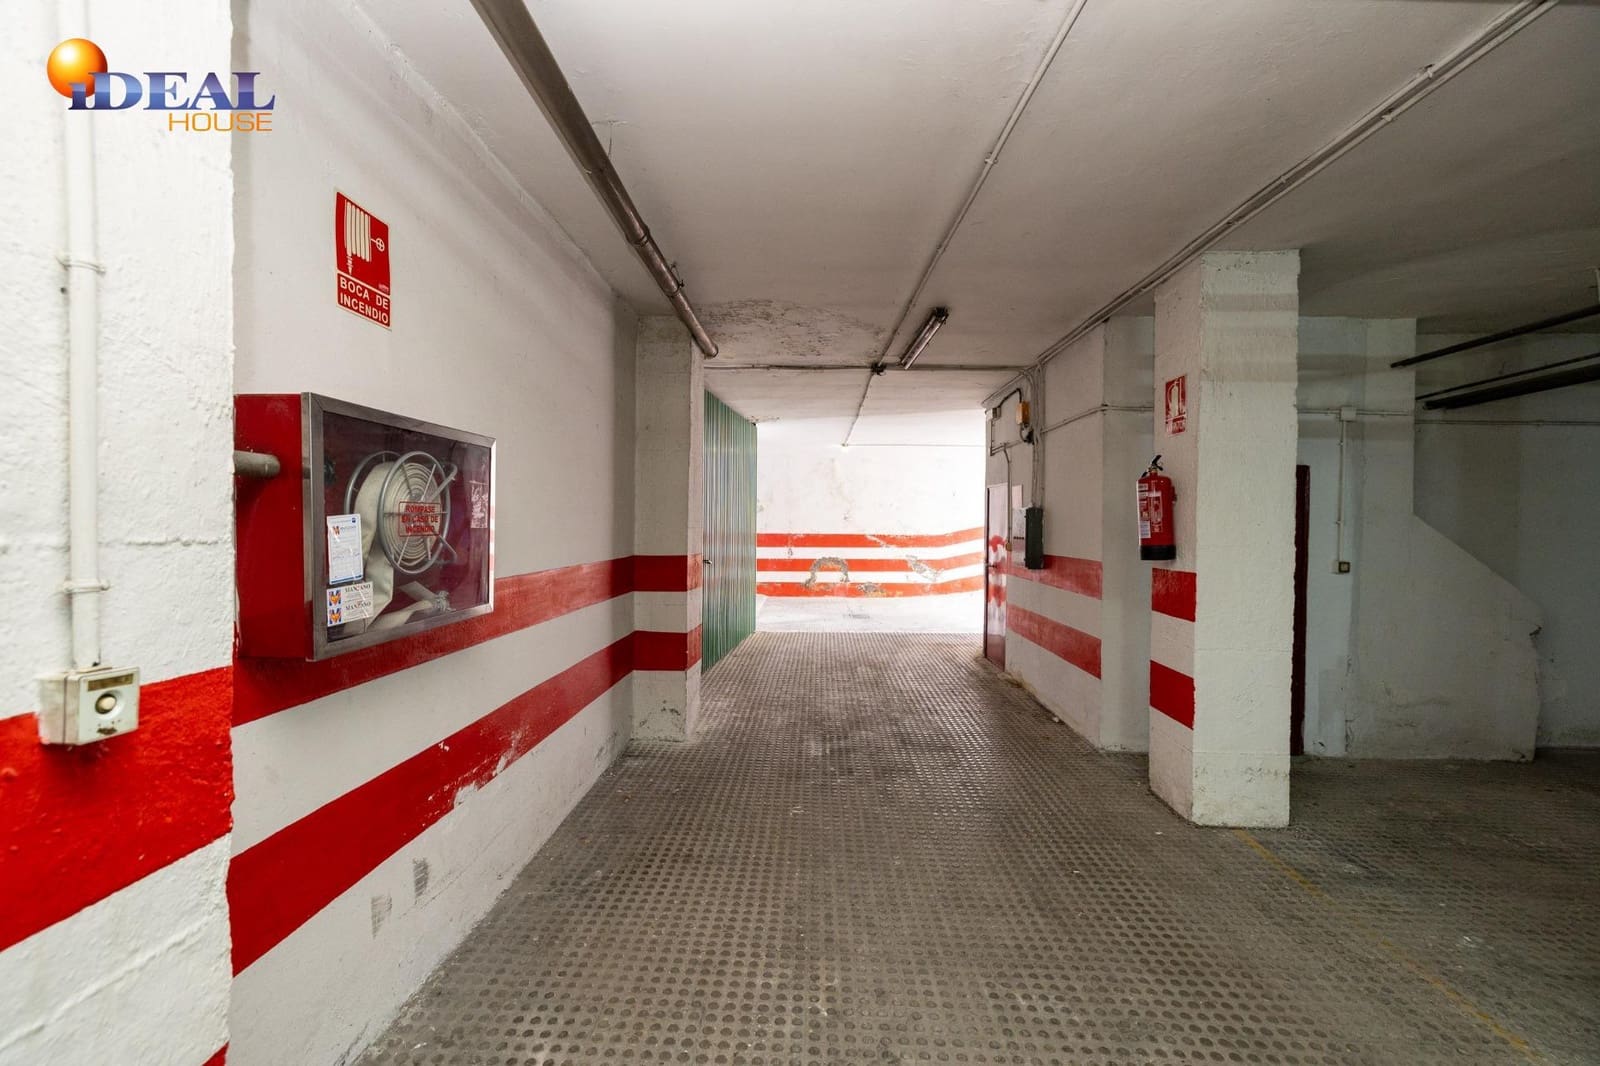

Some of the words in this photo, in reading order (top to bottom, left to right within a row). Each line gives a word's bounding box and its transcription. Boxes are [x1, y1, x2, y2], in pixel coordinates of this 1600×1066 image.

[340, 276, 370, 301] BOCA
[376, 294, 389, 310] DE
[340, 292, 389, 324] INCENDIO
